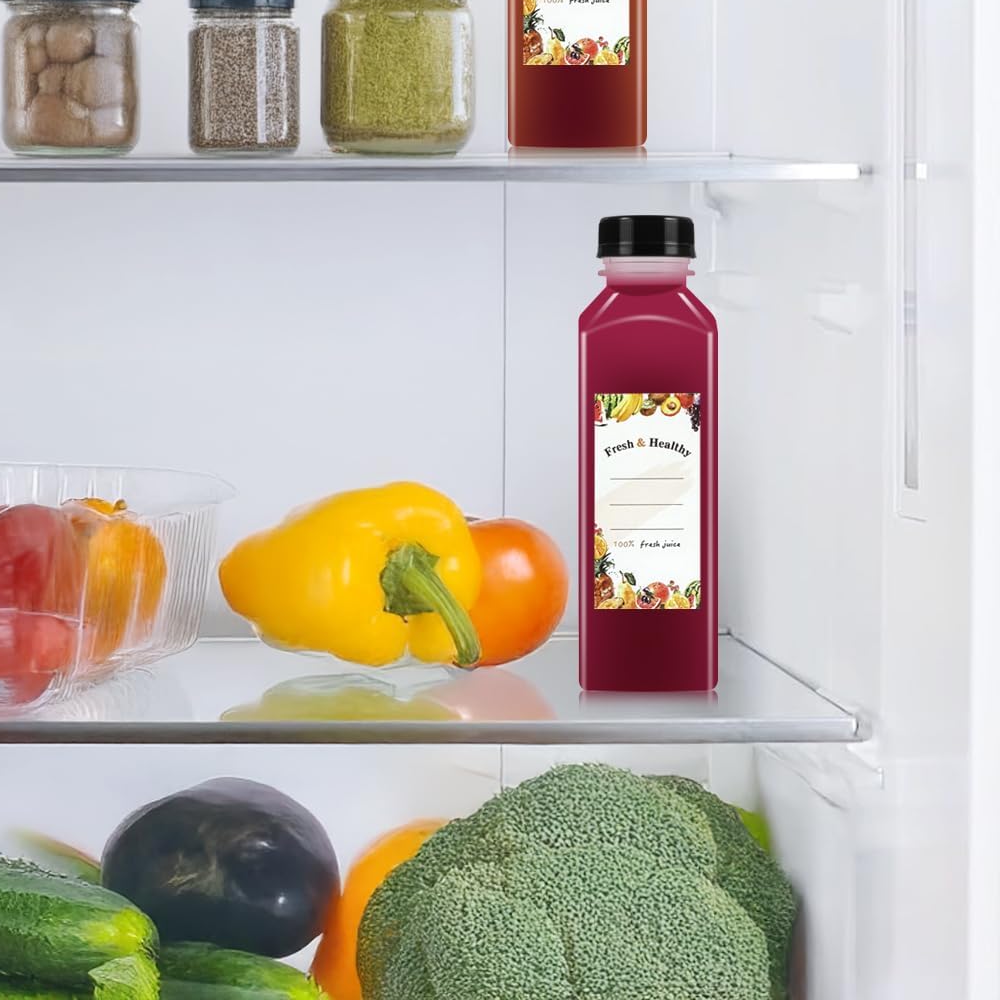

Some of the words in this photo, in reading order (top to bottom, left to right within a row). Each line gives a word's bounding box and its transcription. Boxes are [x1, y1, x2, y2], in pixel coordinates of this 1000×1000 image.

[604, 439, 635, 458] Fresh
[636, 438, 647, 448] &
[649, 437, 692, 459] Healthy
[639, 539, 661, 549] fresh
[661, 540, 681, 549] juice
